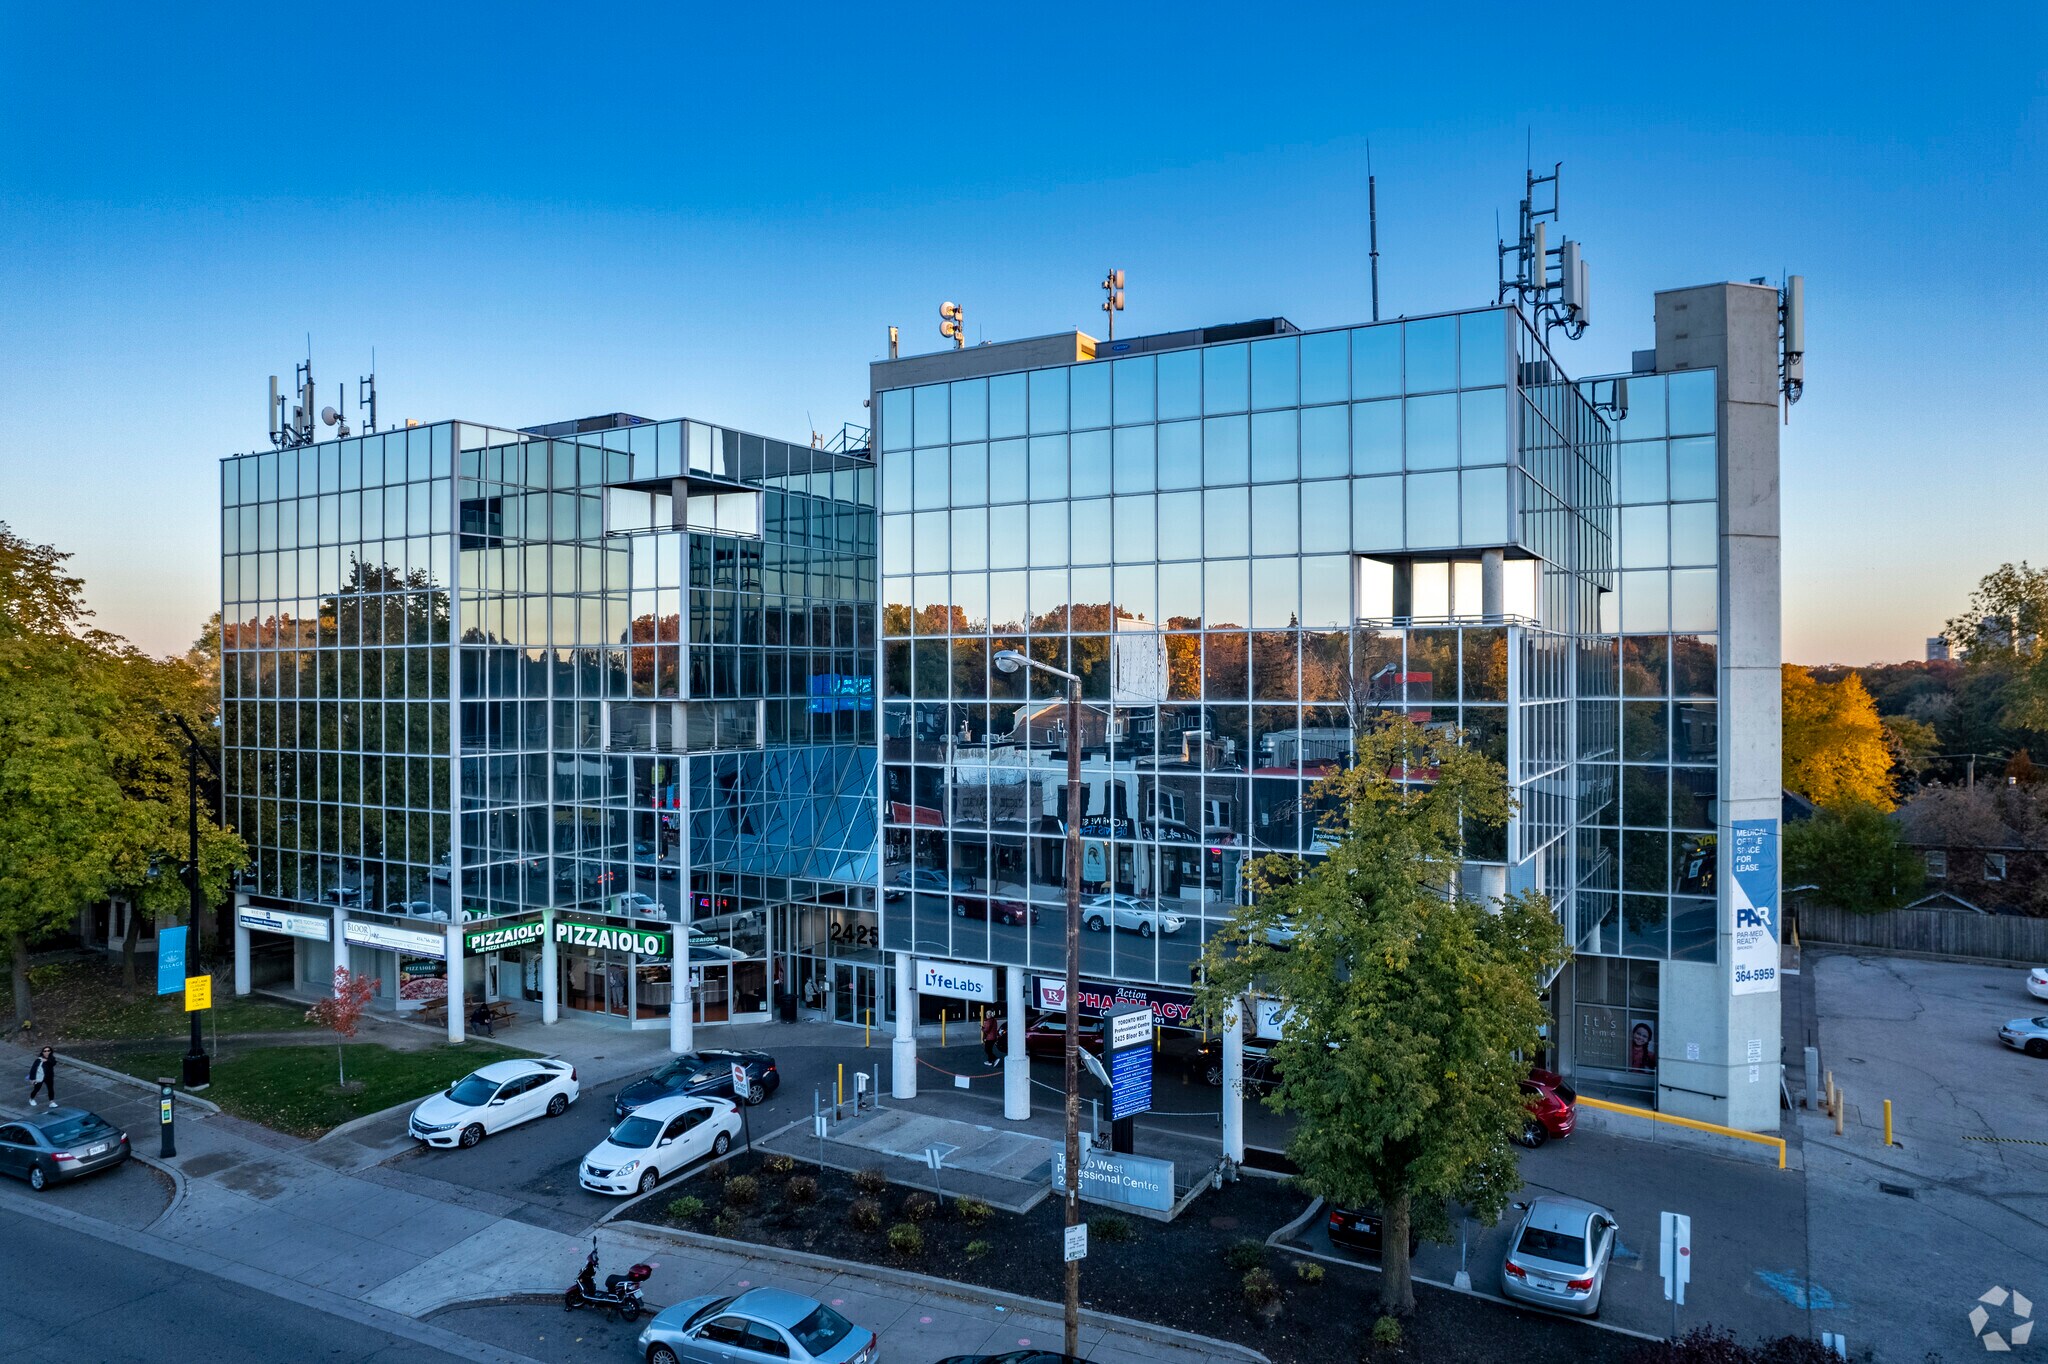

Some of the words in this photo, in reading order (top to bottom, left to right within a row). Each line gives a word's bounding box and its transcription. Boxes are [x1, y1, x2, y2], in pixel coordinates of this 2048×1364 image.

[1736, 829, 1768, 837] MEDICAL
[1736, 864, 1760, 872] LEASE
[1737, 907, 1772, 928] PAR
[471, 923, 544, 948] PIZZAIOLO
[556, 924, 658, 955] PIZZAIOLO
[830, 922, 879, 948] 2425
[1737, 930, 1764, 938] PAR-MED
[925, 969, 982, 993] LifeLabs
[1735, 968, 1775, 982] 364-5959
[1115, 987, 1147, 999] Action
[1114, 1024, 1138, 1034] Professional
[1137, 1021, 1150, 1029] Centre
[1117, 1017, 1136, 1026] TORONTO
[1584, 1014, 1616, 1029] It's
[1114, 1035, 1126, 1043] 2425
[1126, 1032, 1138, 1041] Bloor
[1584, 1027, 1616, 1038] time
[1096, 1159, 1124, 1174] West
[1057, 1164, 1120, 1185] Pressional
[1122, 1176, 1159, 1192] Centre
